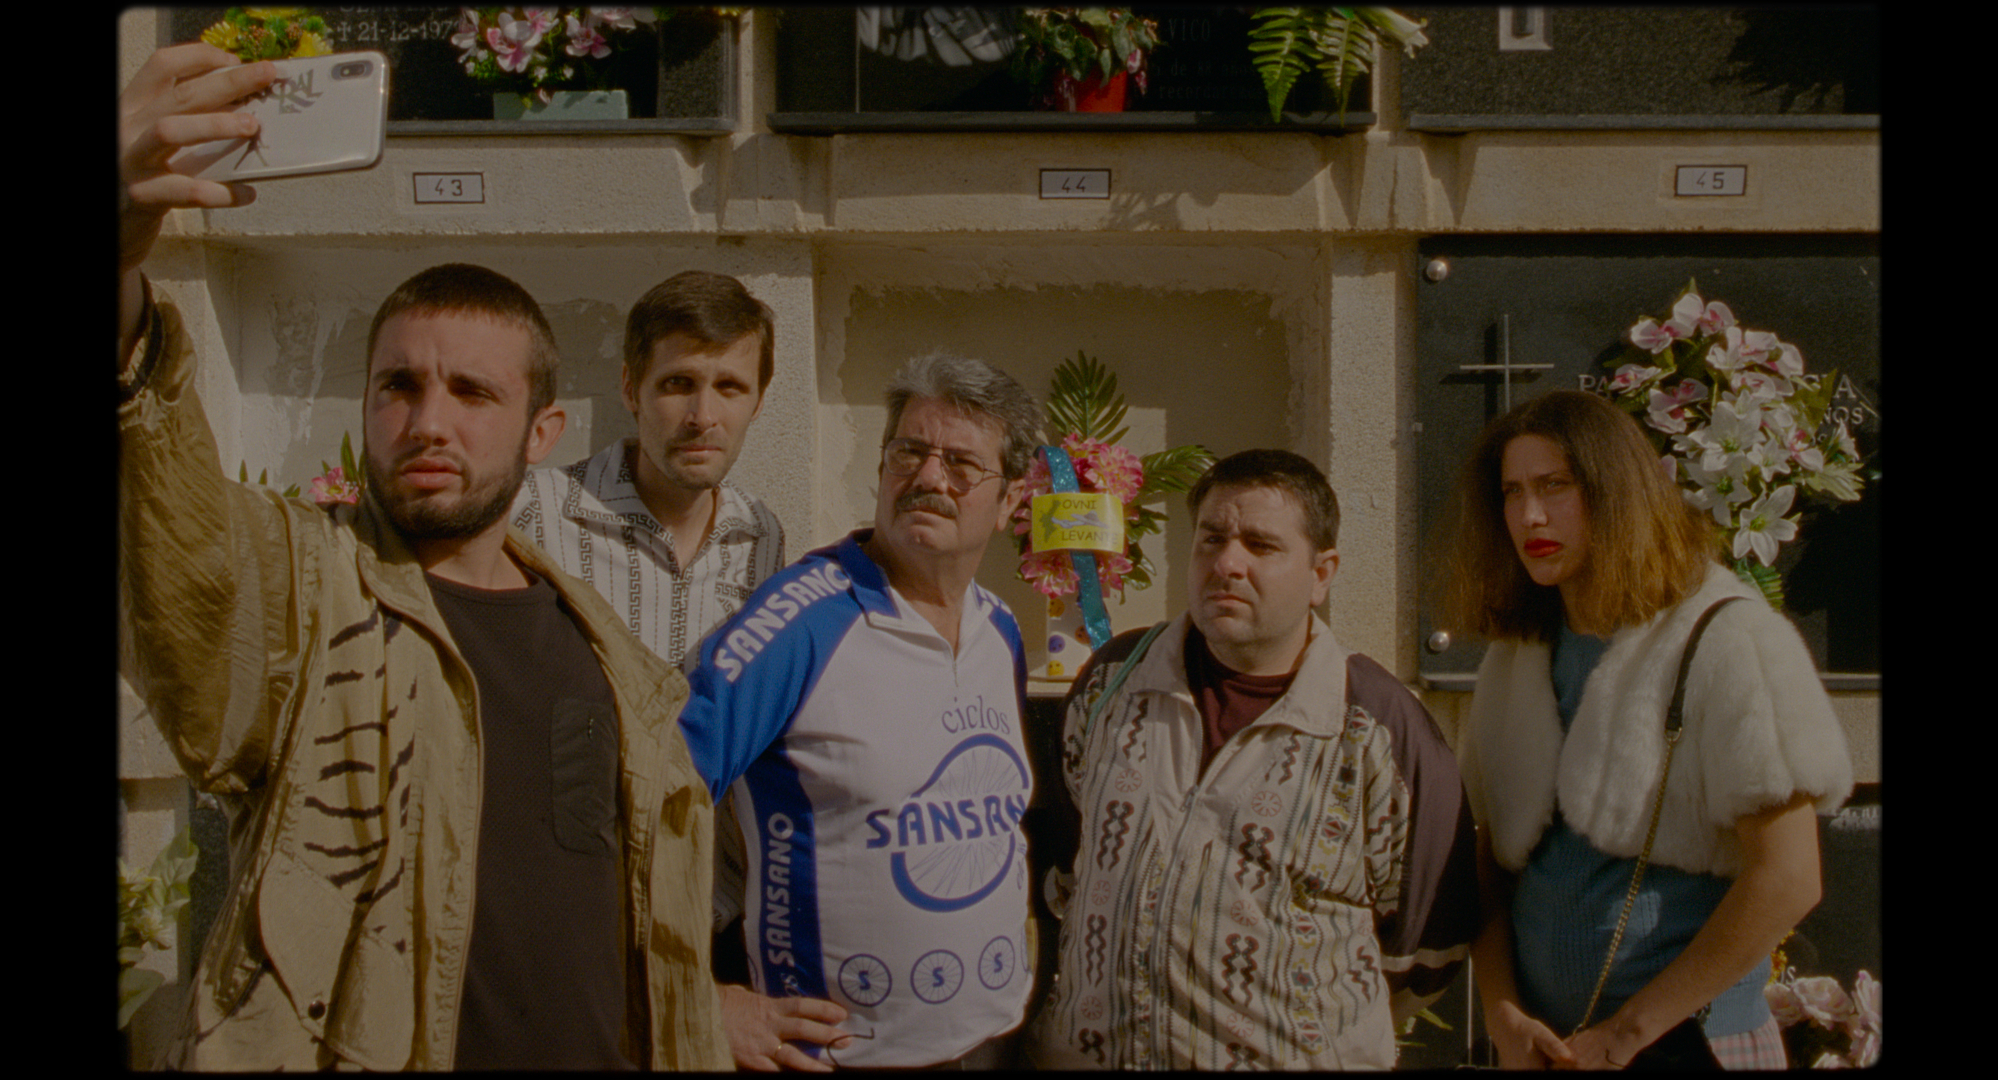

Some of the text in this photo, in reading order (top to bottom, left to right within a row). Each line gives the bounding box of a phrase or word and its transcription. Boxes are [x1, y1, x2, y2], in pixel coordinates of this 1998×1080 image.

[434, 178, 463, 197] 43
[1061, 176, 1086, 194] 44
[1696, 171, 1725, 190] 45
[1062, 499, 1097, 510] OVNI
[941, 695, 1010, 735] ciclos
[866, 793, 1027, 850] SANSAN
[766, 811, 796, 968] SANSANO
